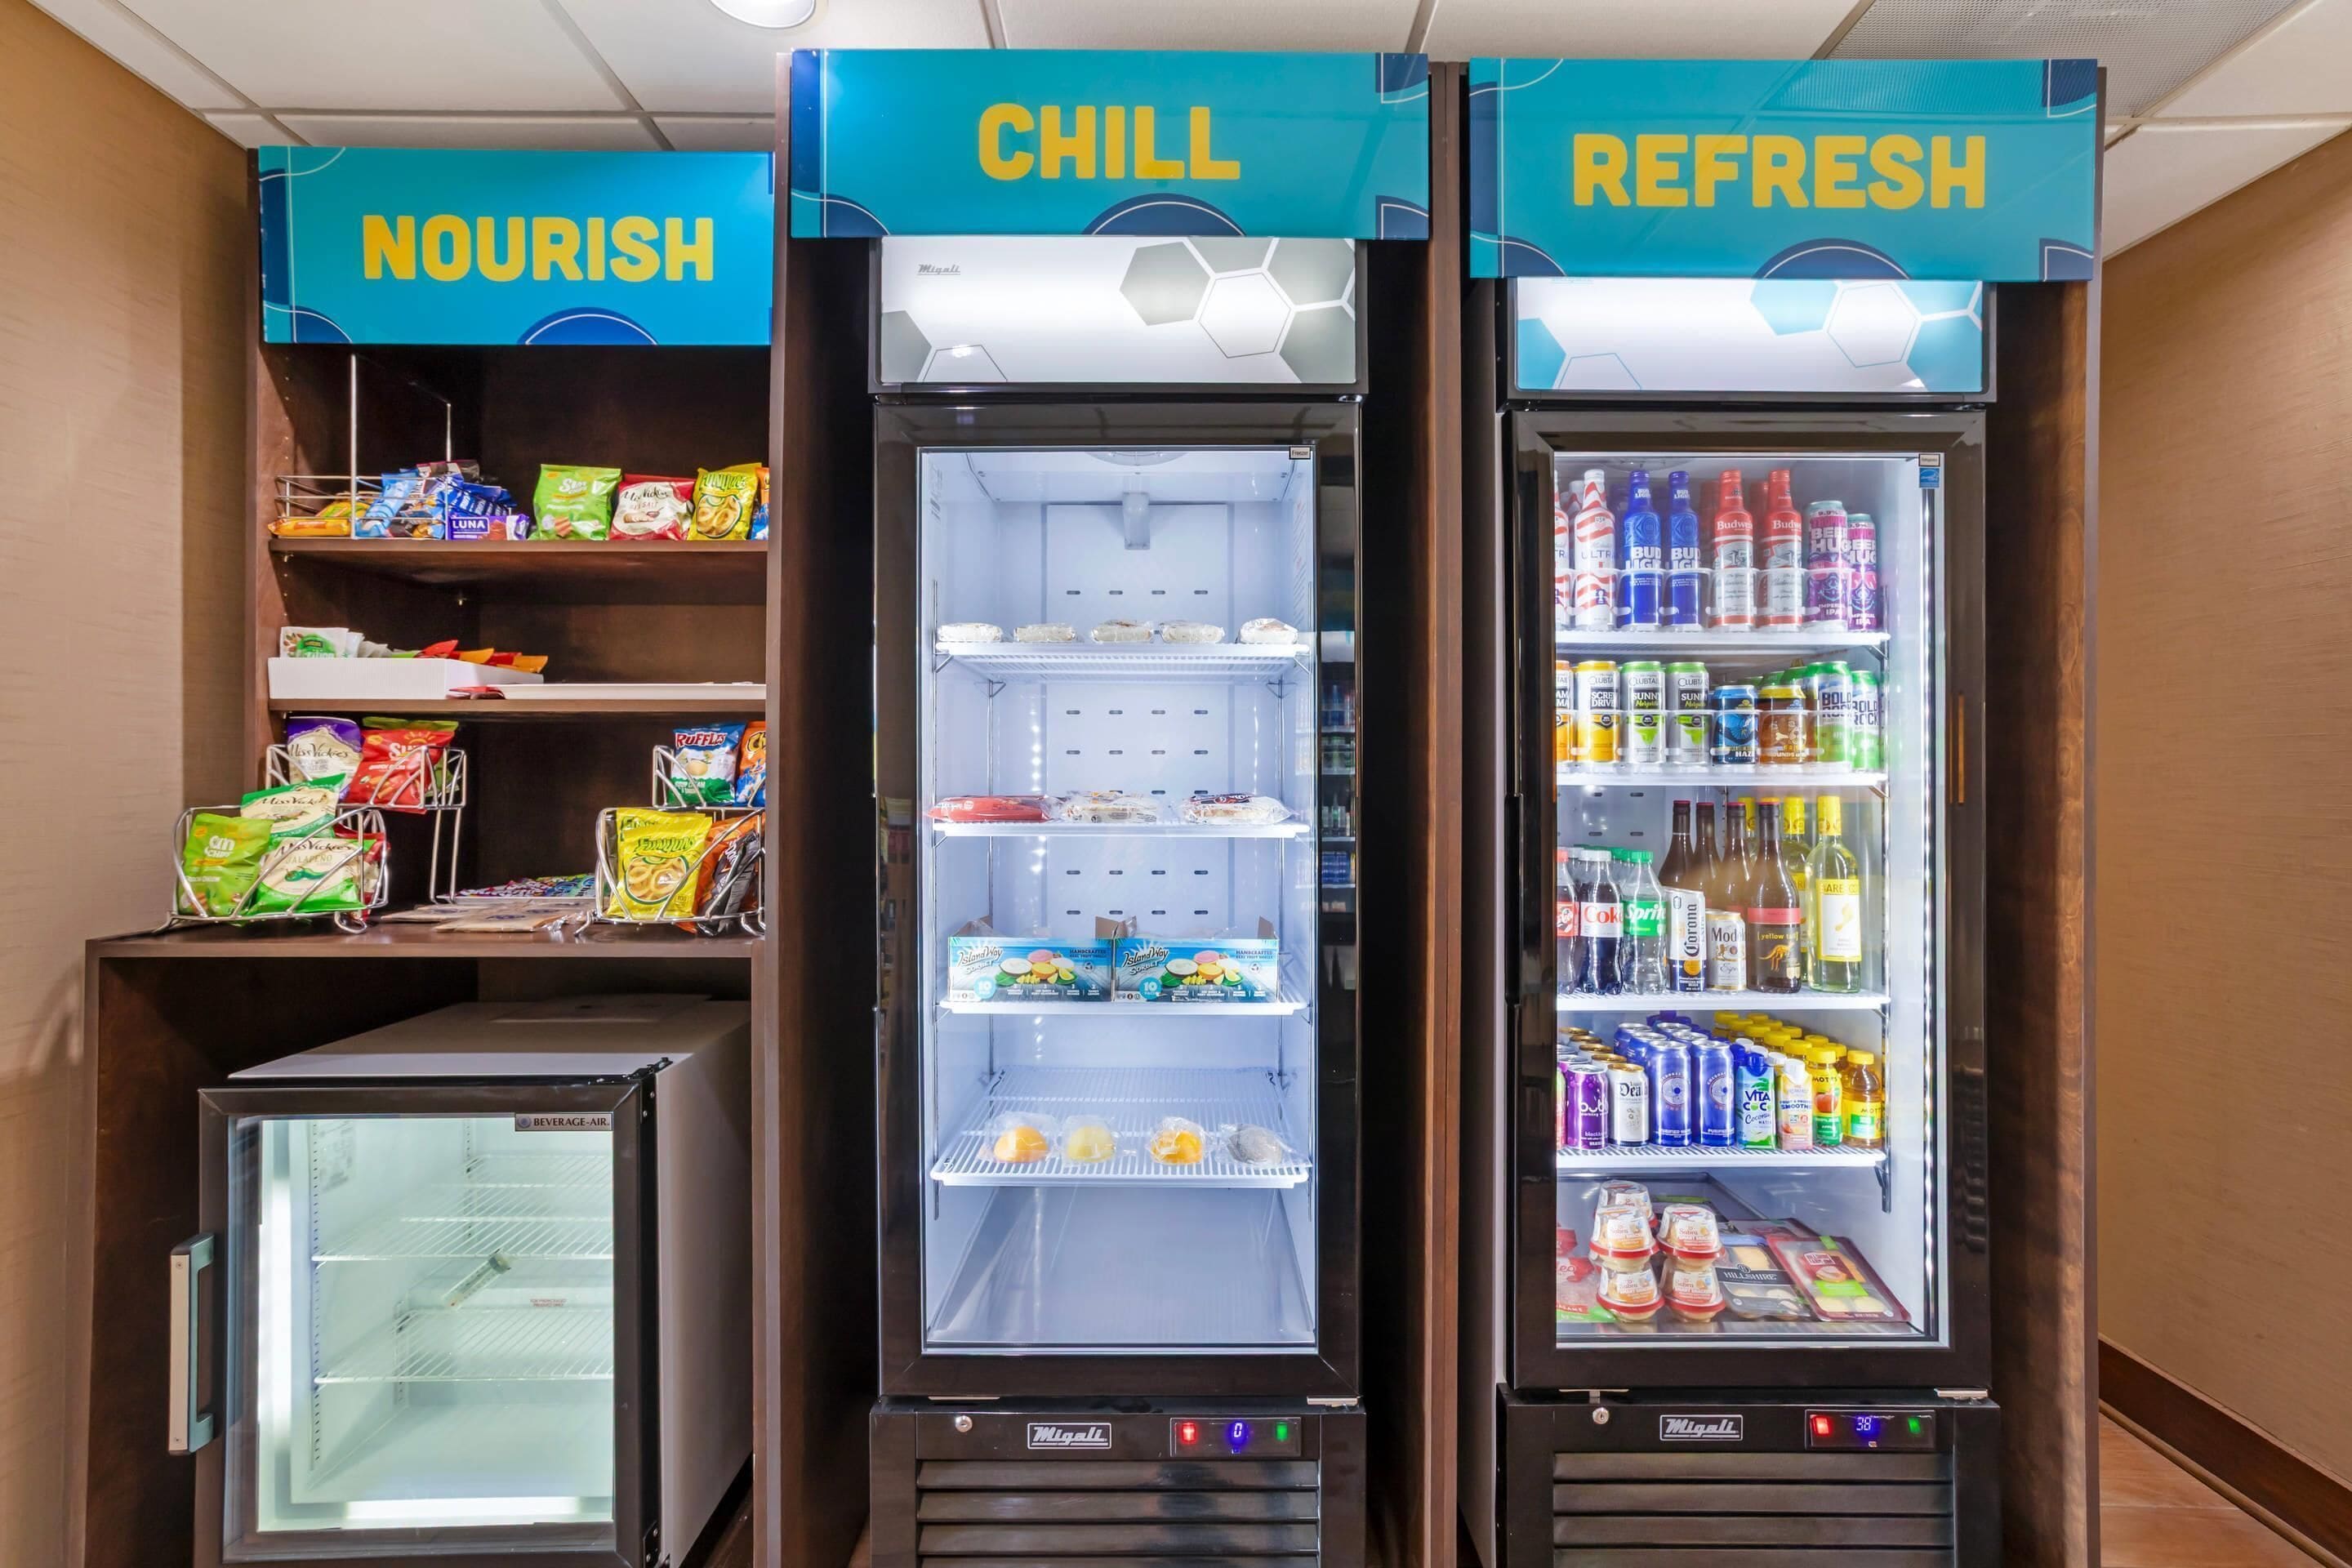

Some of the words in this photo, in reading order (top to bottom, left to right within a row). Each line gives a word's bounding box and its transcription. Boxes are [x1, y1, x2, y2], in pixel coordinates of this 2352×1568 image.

[978, 104, 1241, 180] CHILL
[1573, 133, 1986, 209] REFRESH
[363, 214, 713, 282] NOURISH
[918, 264, 960, 275] Migali
[452, 520, 485, 528] LUNA
[1633, 546, 1661, 559] BUD
[1672, 547, 1701, 559] BUD
[675, 732, 728, 747] RUFFLES
[1683, 902, 1700, 957] Corona
[1151, 945, 1169, 962] Way
[1745, 1090, 1771, 1101] VITA
[533, 1117, 608, 1126] BEVERAGE-AIR
[1723, 1271, 1777, 1281] HILLSHIRE
[1233, 1422, 1243, 1437] 0
[1664, 1419, 1739, 1437] Migali
[1855, 1417, 1871, 1431] 38
[1032, 1426, 1105, 1446] Migali
